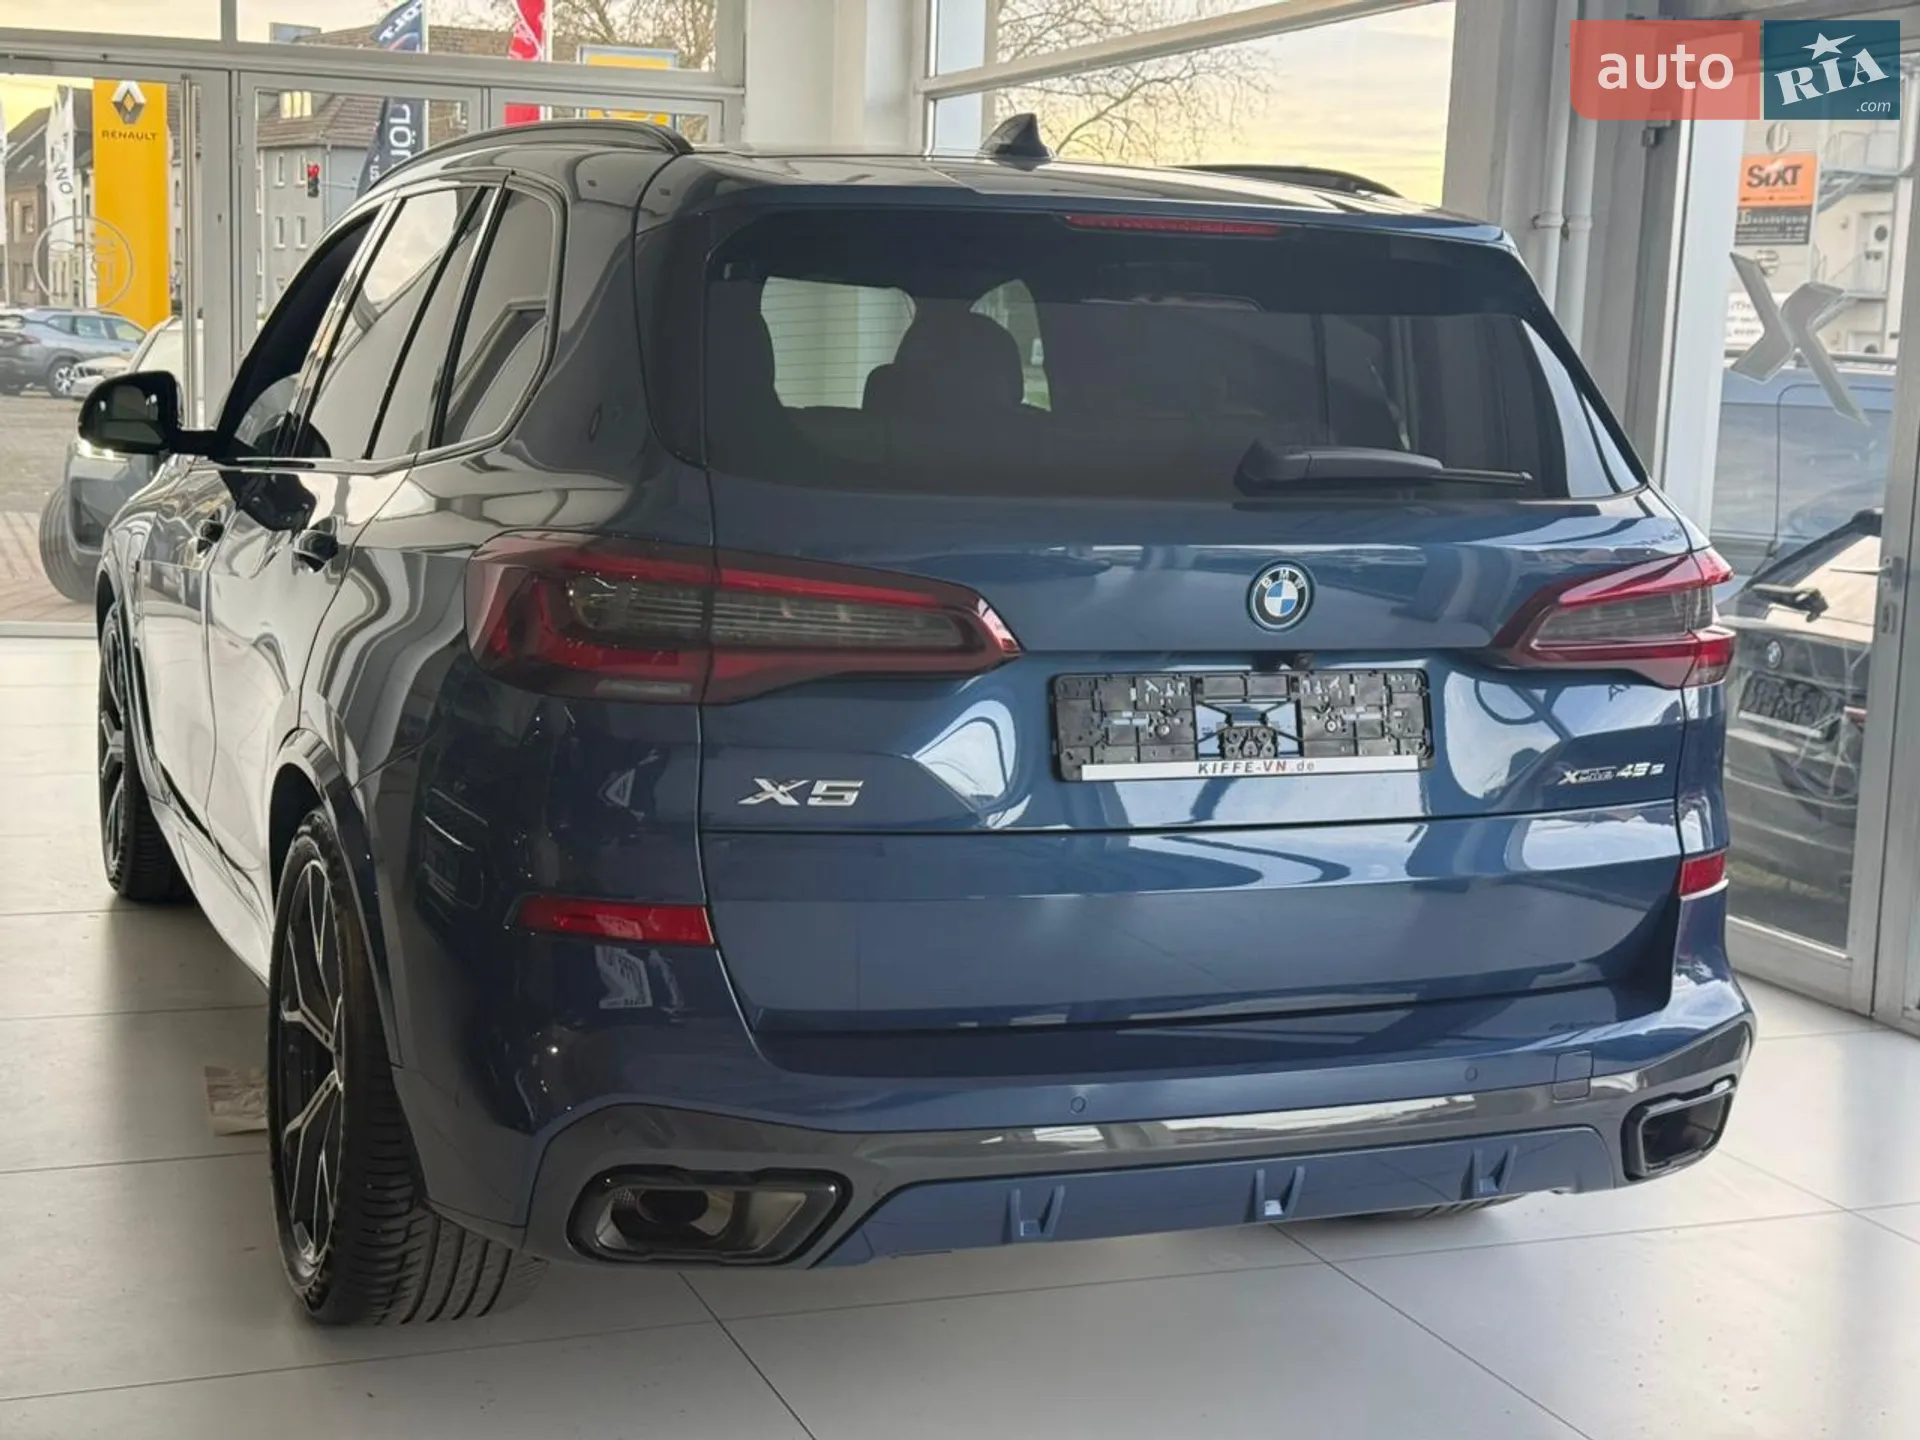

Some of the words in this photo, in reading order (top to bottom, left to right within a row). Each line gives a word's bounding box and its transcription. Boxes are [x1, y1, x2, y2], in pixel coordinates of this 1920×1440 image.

[101, 130, 157, 141] RENAULT
[1261, 569, 1306, 589] BMW
[737, 777, 865, 807] X5
